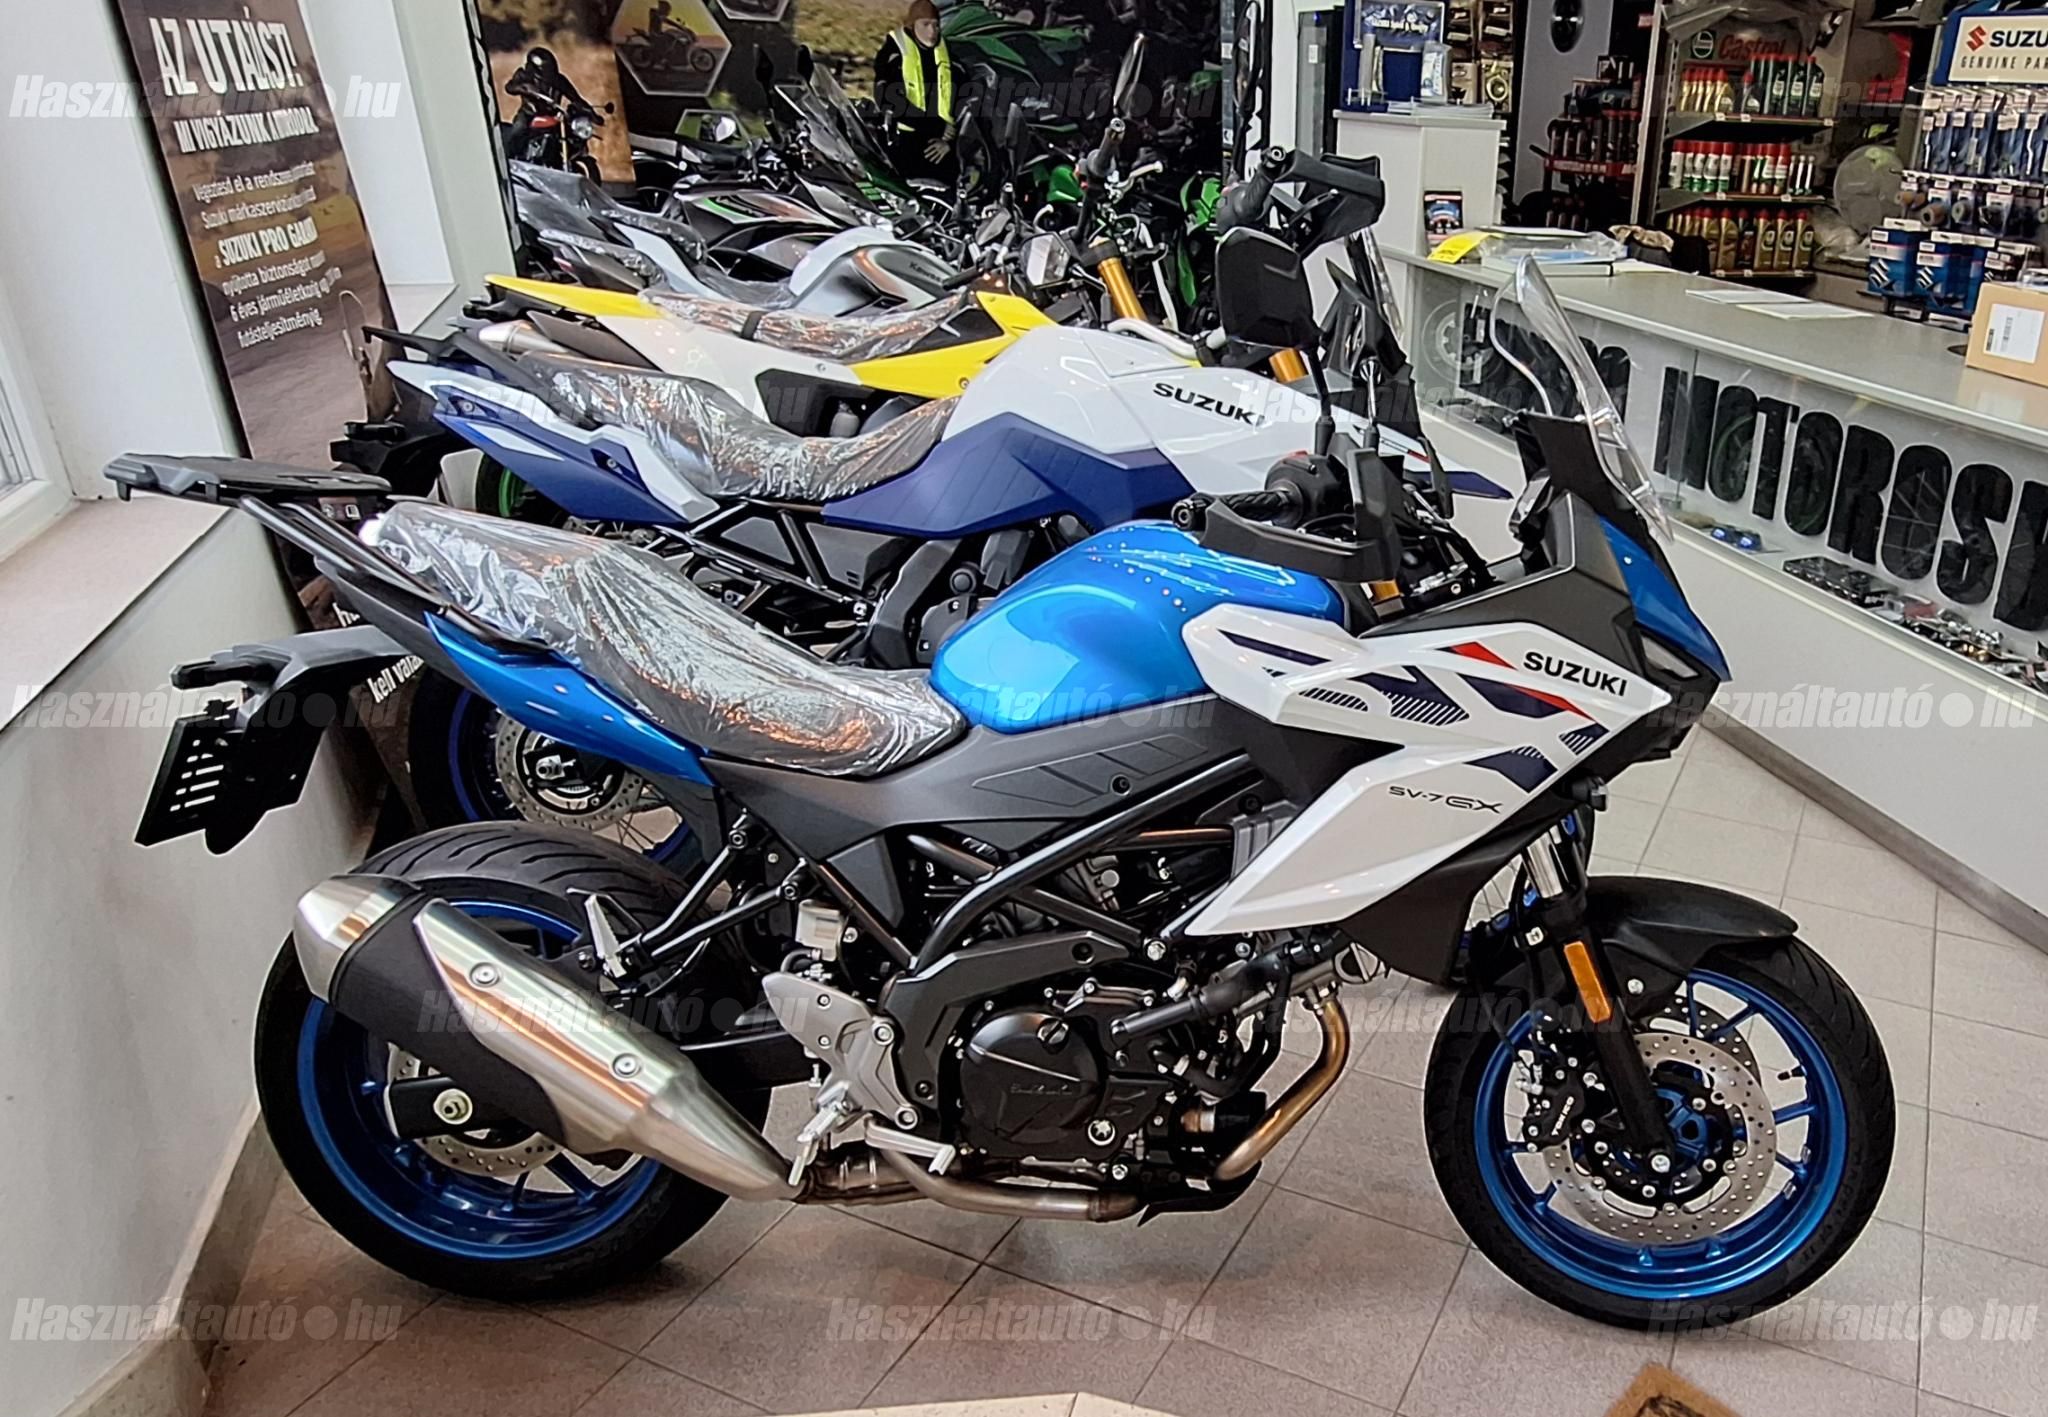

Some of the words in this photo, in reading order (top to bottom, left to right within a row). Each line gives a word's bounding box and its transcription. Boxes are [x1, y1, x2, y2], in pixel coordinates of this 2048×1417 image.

[149, 18, 199, 97] AZ
[1960, 56, 2017, 70] GENUINE
[218, 229, 262, 266] SUZUKI
[259, 225, 290, 255] PRO
[237, 301, 259, 320] éves
[1153, 382, 1265, 427] SUZUKI
[366, 667, 397, 703] kell
[1523, 651, 1628, 697] SUZUKI
